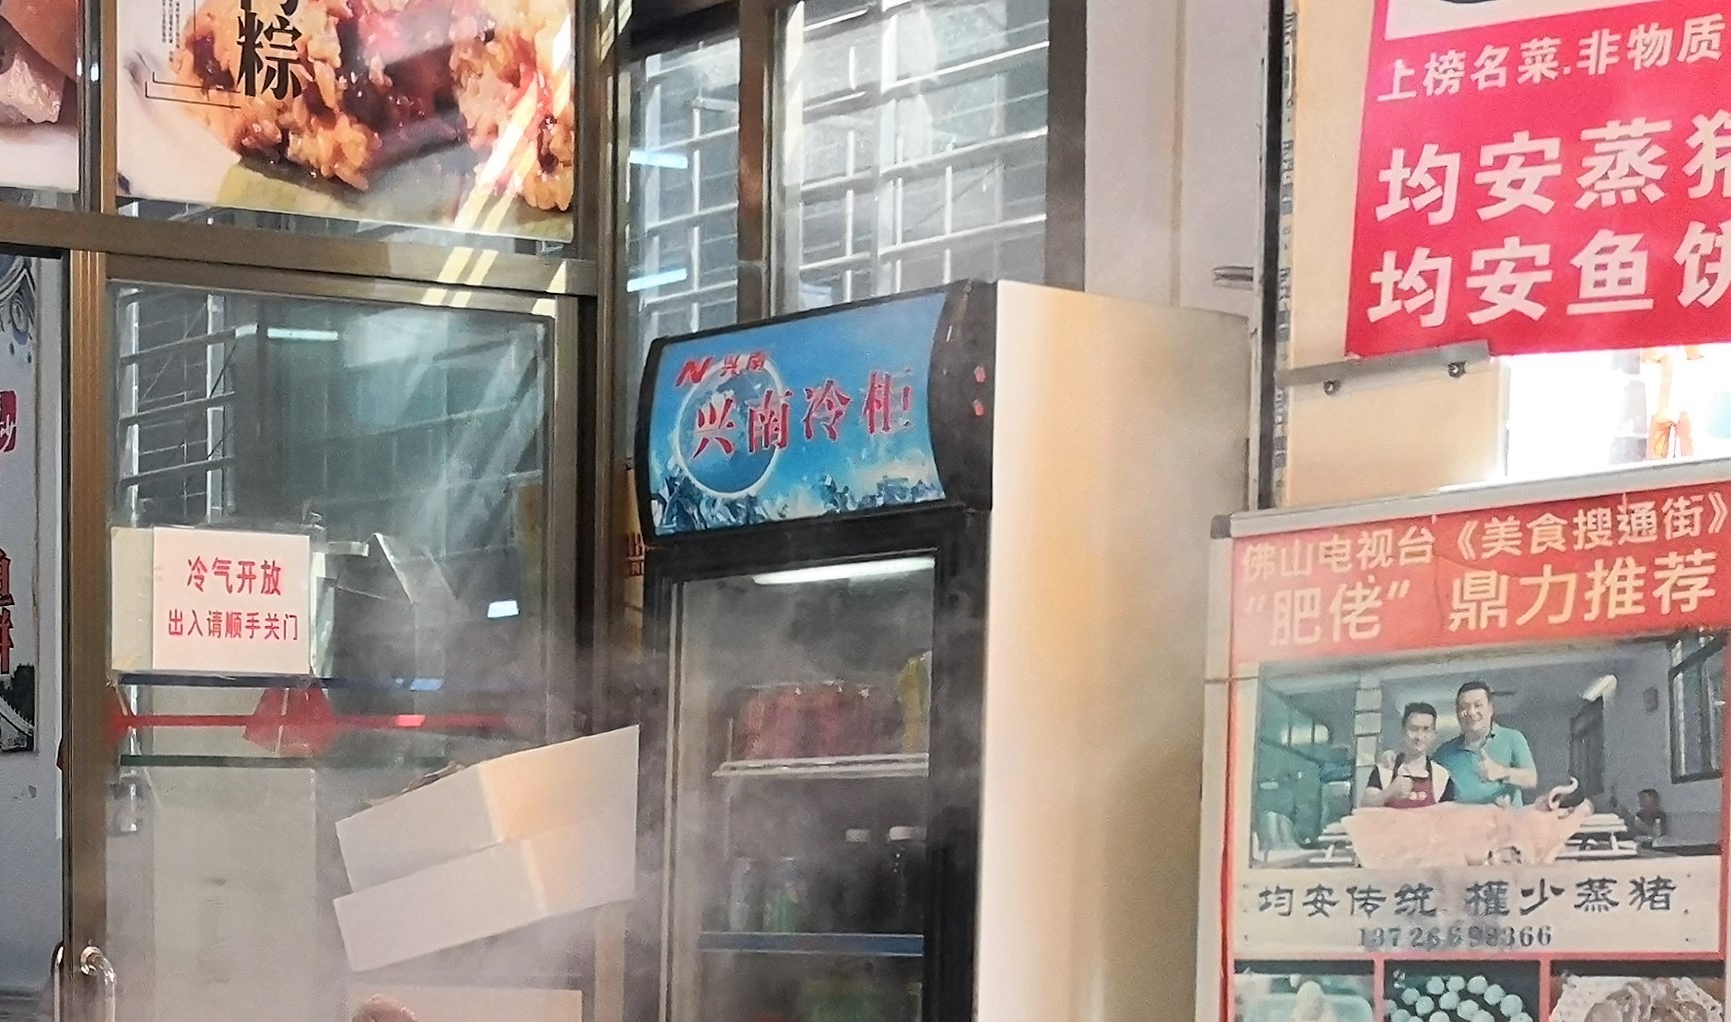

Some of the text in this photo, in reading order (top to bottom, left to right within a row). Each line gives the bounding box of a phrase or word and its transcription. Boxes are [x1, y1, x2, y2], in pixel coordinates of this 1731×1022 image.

[691, 368, 913, 459] 兴南冷柜
[186, 556, 282, 596] 冷气开放
[167, 608, 299, 641] 出入请顺手关门
[1257, 883, 1439, 919] 均安传统
